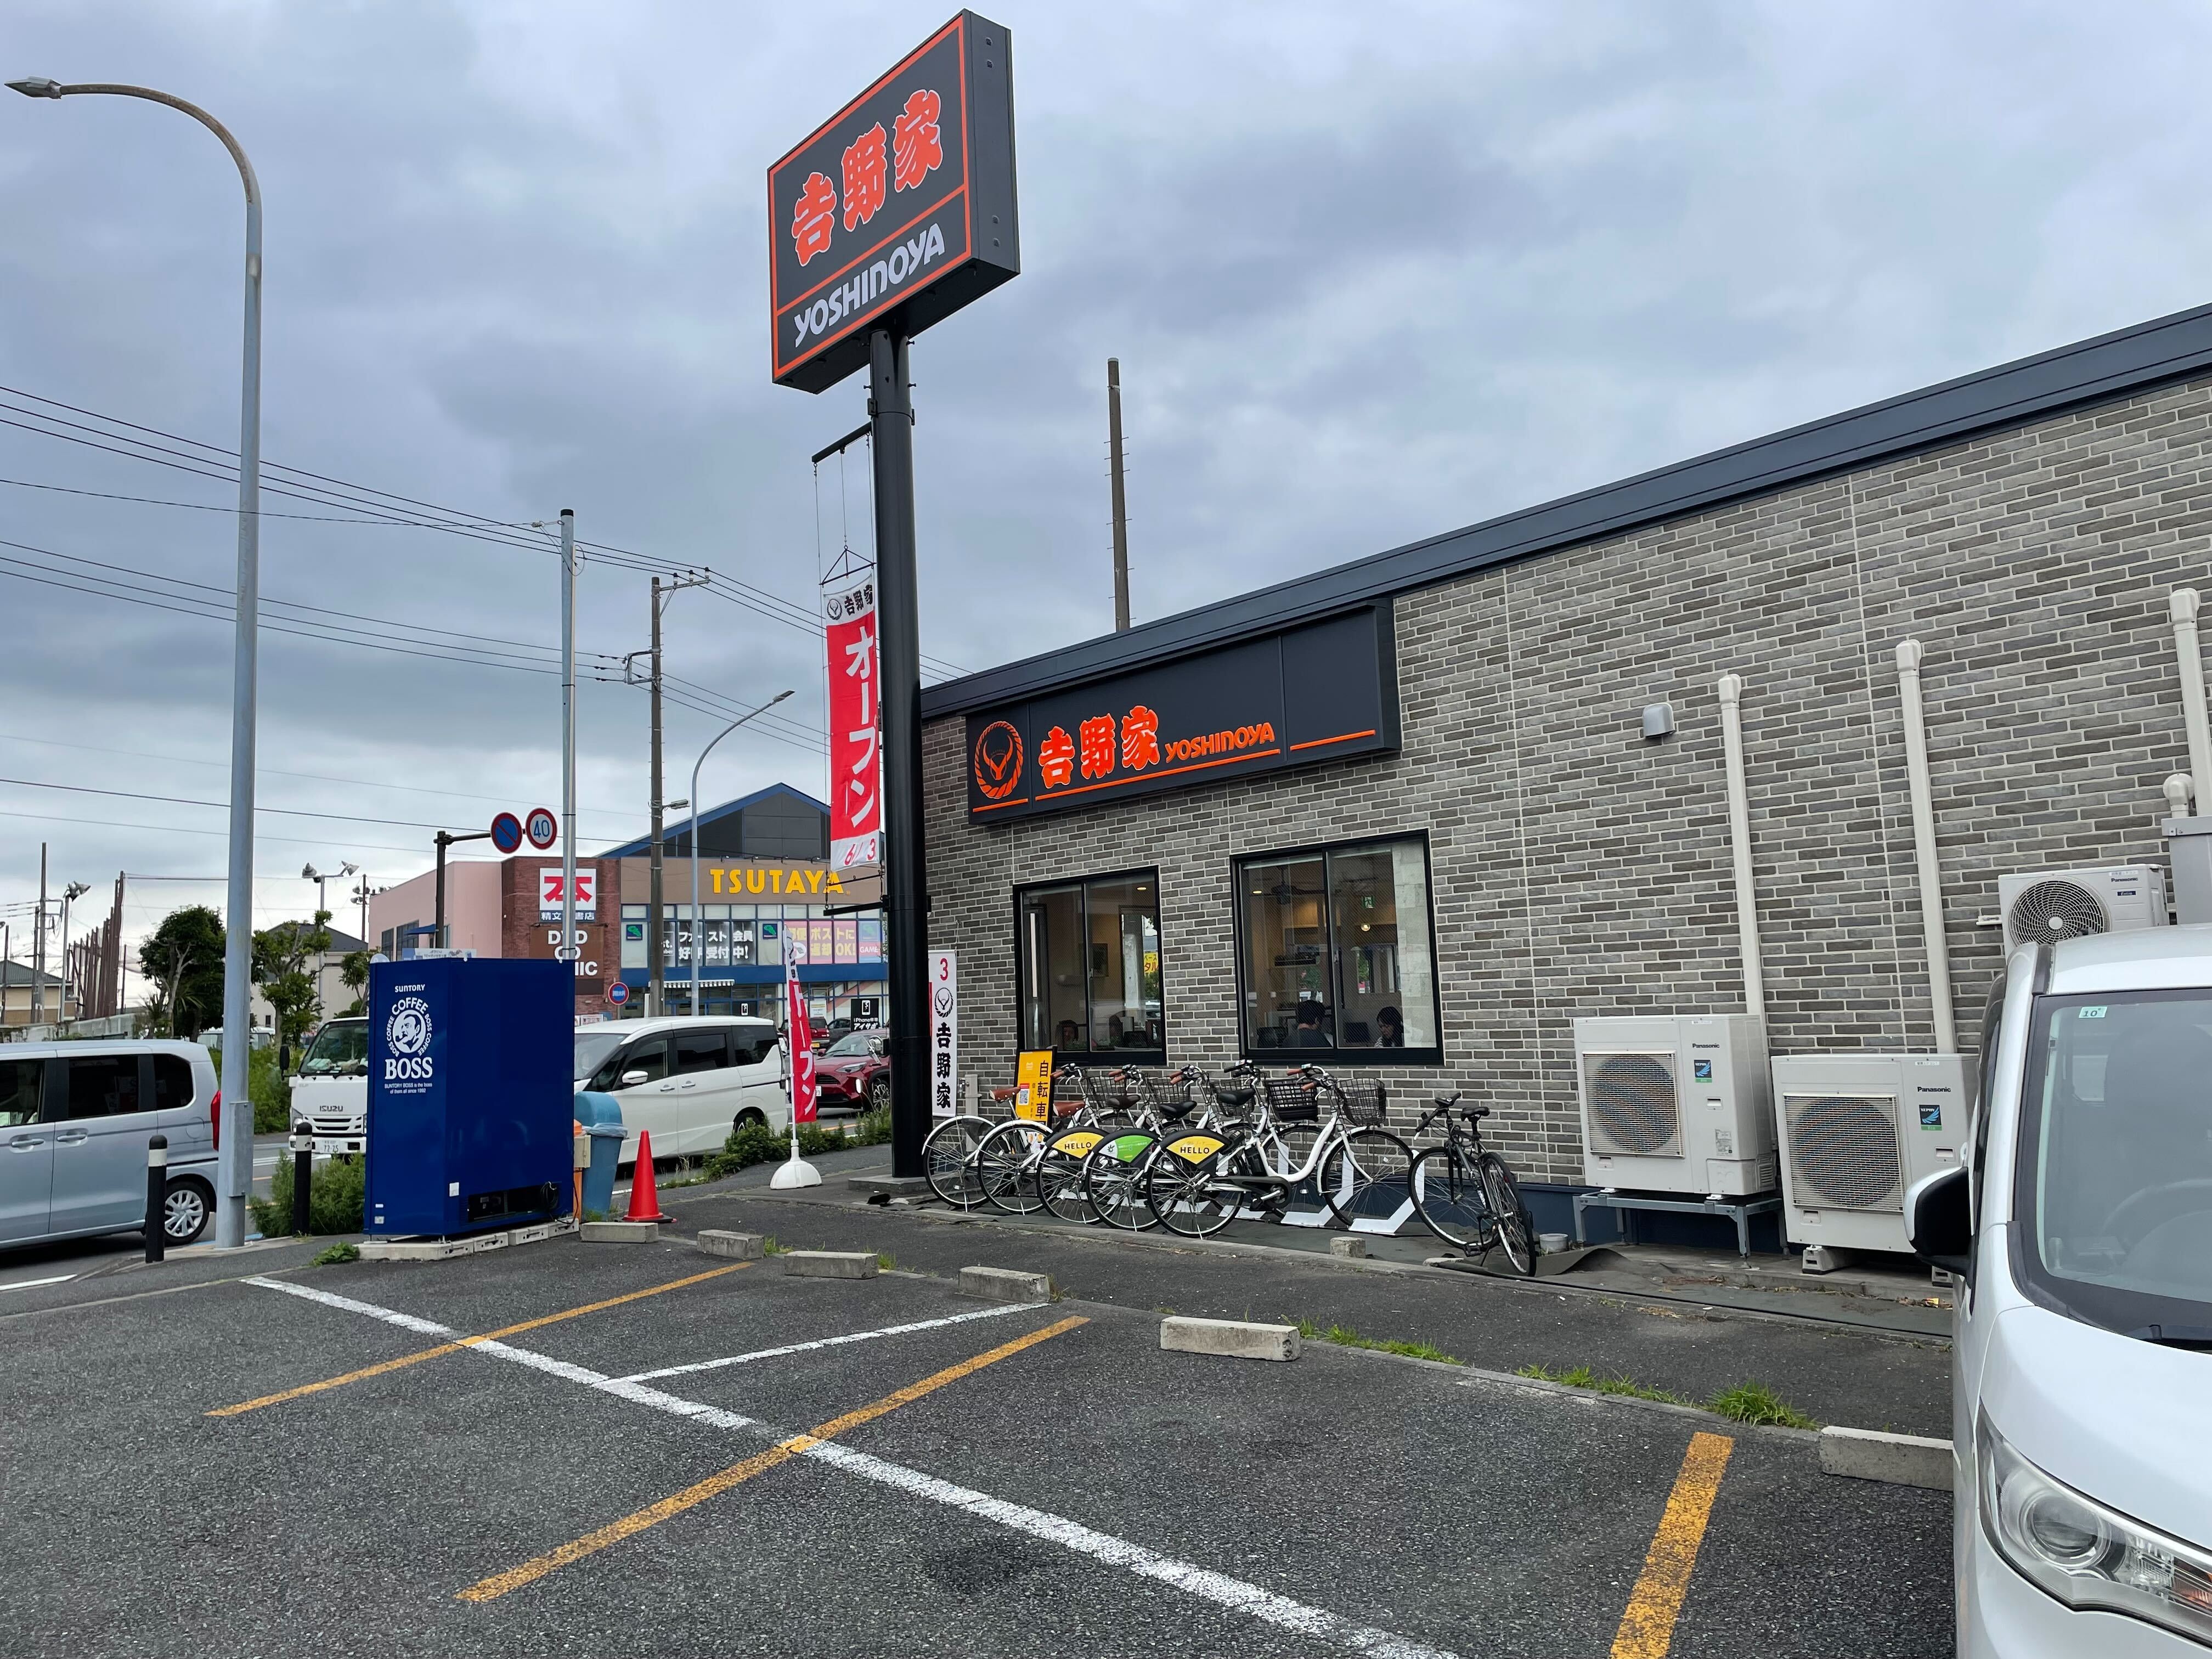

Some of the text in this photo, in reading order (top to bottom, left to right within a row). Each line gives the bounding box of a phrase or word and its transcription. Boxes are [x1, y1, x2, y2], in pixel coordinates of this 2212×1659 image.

[794, 223, 945, 348] YOSHINOYA
[845, 626, 877, 828] オープン
[1164, 722, 1276, 762] YOSHINOYA
[533, 820, 550, 838] 40
[709, 868, 844, 894] TSUTAYA
[541, 912, 595, 921] 精文書店
[548, 930, 588, 945] DD
[394, 984, 426, 993] SUNTORY
[392, 997, 428, 1015] COFFEE
[385, 1057, 433, 1080] BOSS
[1035, 1060, 1049, 1119] 自転車
[1064, 1142, 1092, 1150] HELLO
